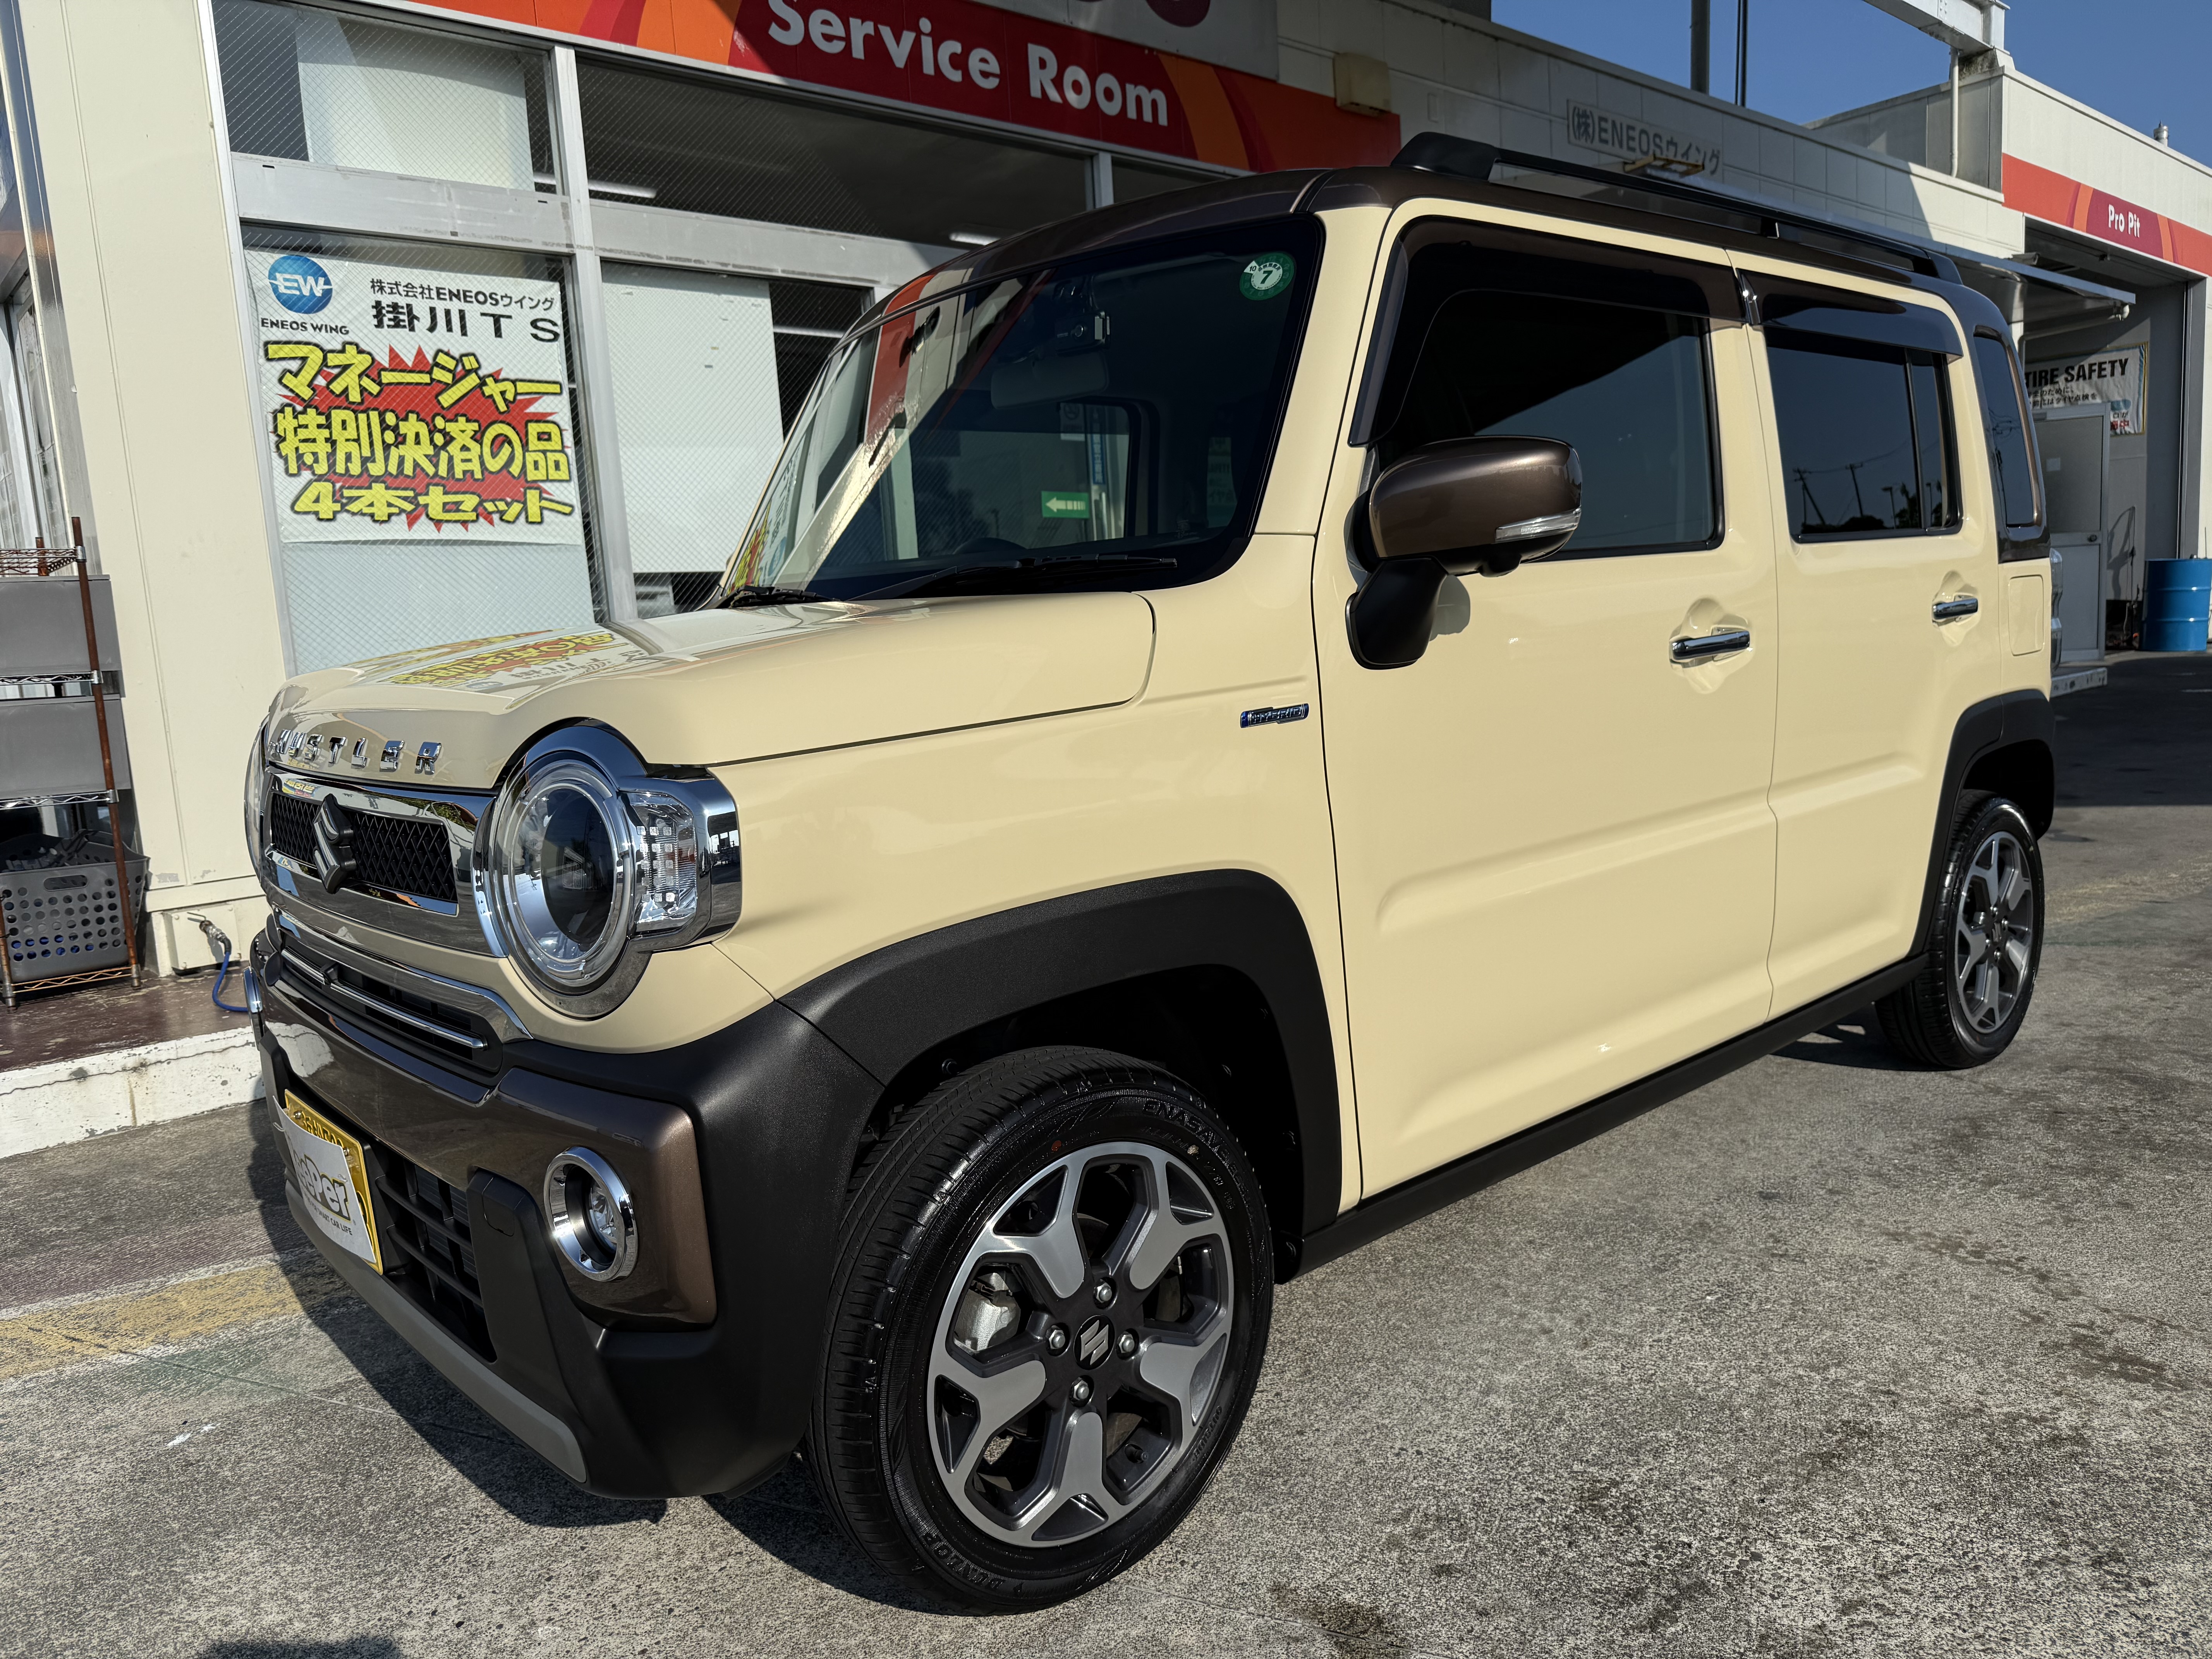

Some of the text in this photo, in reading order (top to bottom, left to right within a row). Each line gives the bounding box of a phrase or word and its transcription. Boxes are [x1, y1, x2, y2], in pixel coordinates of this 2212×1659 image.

[768, 0, 1168, 127] Service Room
[2108, 204, 2140, 238] Pro Pit
[274, 272, 325, 297] EW
[1260, 270, 1273, 284] 7
[369, 278, 555, 311] 株式会社ENEOSウイング
[261, 318, 349, 336] ENEOS WING
[266, 342, 563, 413] マネージャー
[2025, 358, 2129, 388] TIRE SAFETY
[274, 406, 571, 481] 特別決済の品
[292, 481, 575, 524] 4本セット
[270, 728, 442, 775] HUSTLER
[330, 1218, 340, 1230] CAR
[340, 1223, 353, 1236] LIFE
